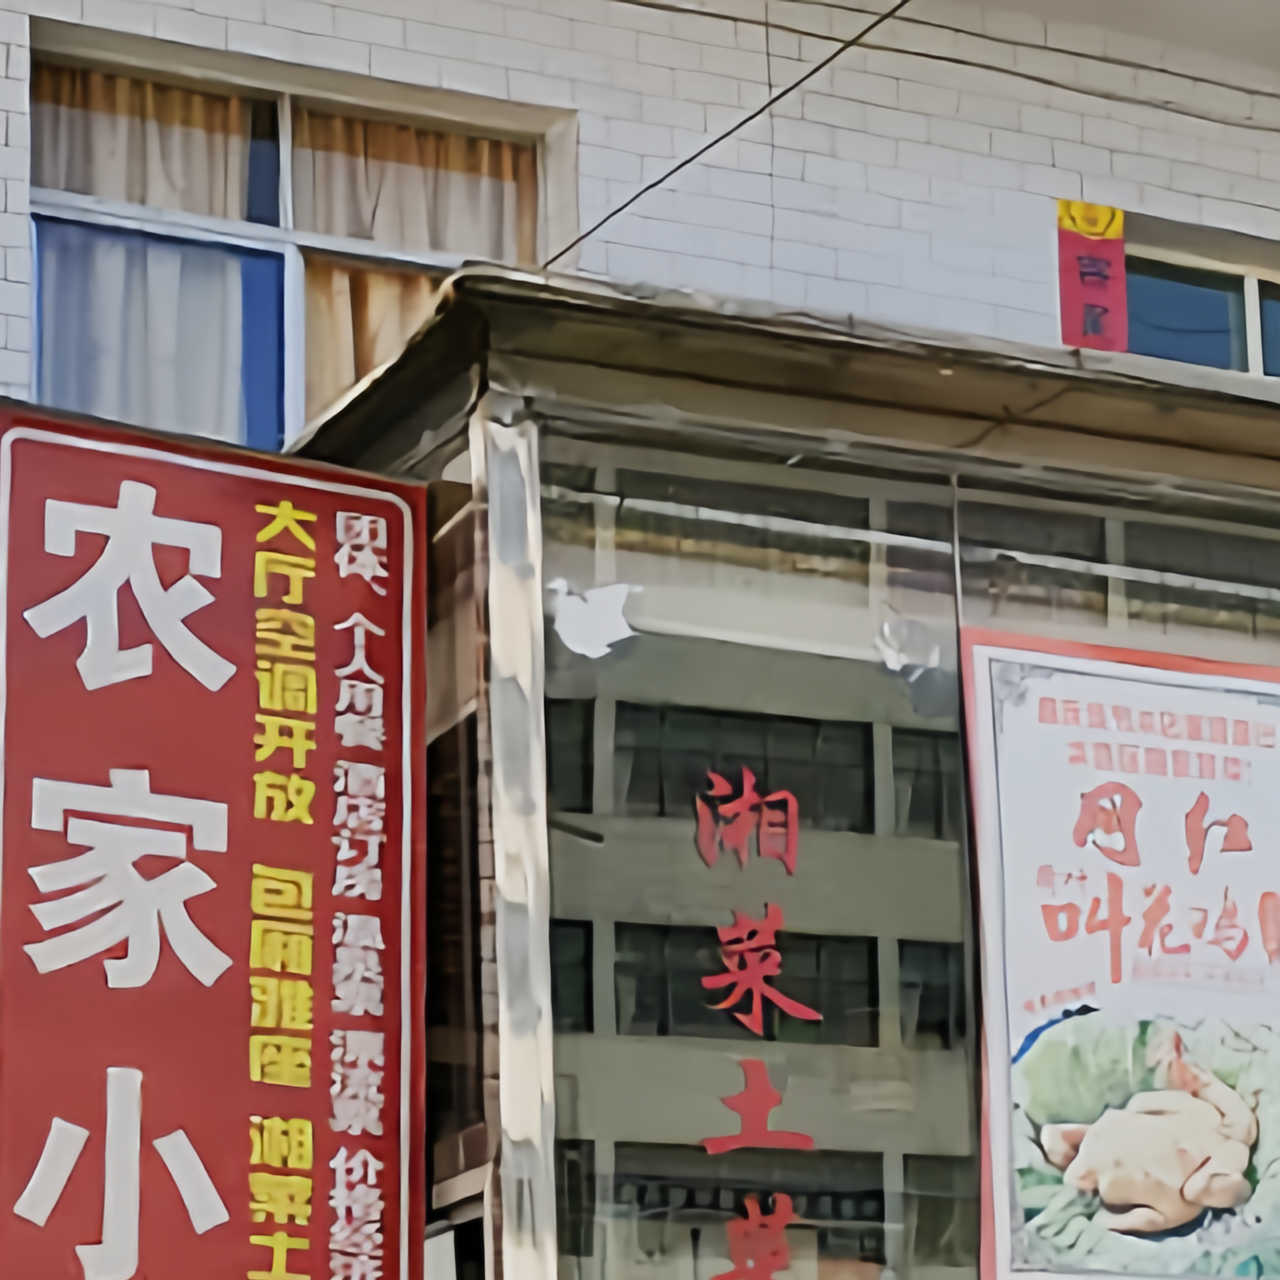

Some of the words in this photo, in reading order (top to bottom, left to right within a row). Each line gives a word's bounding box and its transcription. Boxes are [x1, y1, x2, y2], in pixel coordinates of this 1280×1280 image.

[253, 500, 317, 825] 大厅空调开放
